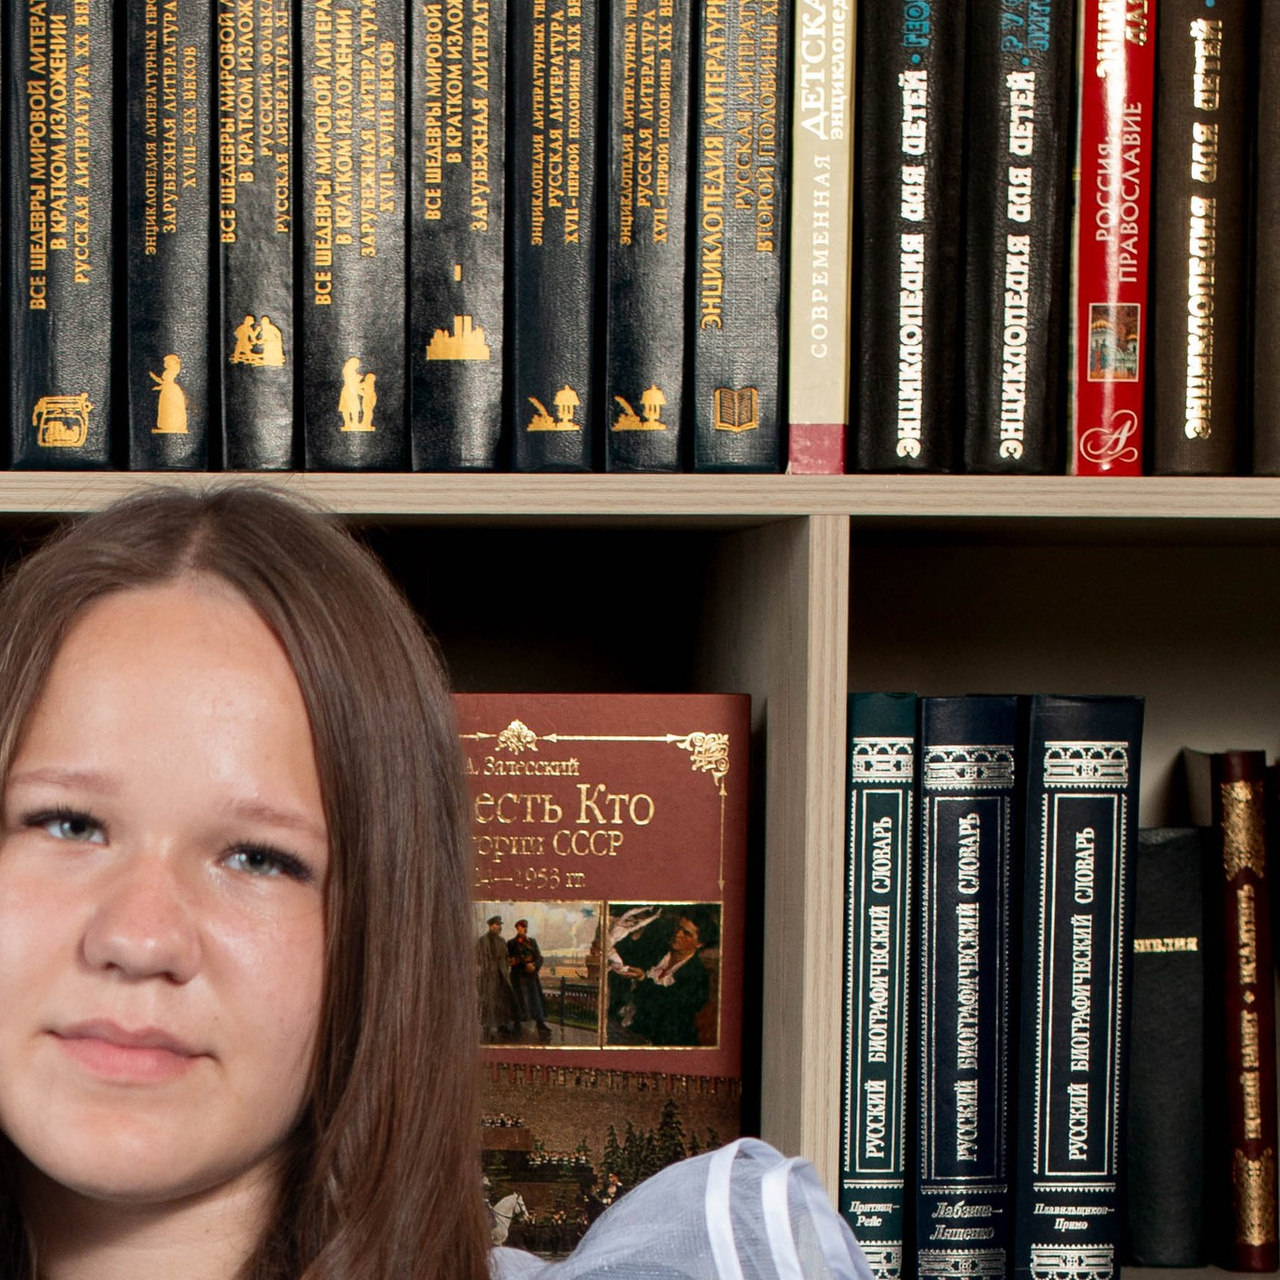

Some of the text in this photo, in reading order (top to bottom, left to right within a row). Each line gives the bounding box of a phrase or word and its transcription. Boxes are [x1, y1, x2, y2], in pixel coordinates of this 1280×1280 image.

[50, 14, 70, 249] В КРАТКОМ ИЗЛОЖЕНИИ
[74, 63, 93, 188] ЛИТЕРАТУРА
[145, 29, 160, 254] ЭНЦИКЛОПЕДИЯ ЛИТЕРАТУРНЫХ
[163, 0, 180, 233] ЗАРУБЕЖНАЯ ЛИТЕРАТУРА
[182, 46, 197, 102] ВЕКОВ
[257, 72, 275, 156] РУССКИЙ
[334, 8, 355, 136] ИЗЛОЖЕНИИ
[548, 9, 567, 207] РУССКАЯ ЛИТЕРАТУРА
[754, 25, 779, 256] ВТОРОЙ ПОЛОВИНЫ
[27, 80, 48, 309] ВСЕ ШЕДЕВРЫ МИРОВОЙ
[74, 194, 92, 283] РУССКАЯ
[701, 136, 728, 336] ЭНЦИКЛОПЕДИЯ
[811, 153, 831, 358] СОВРЕМЕННАЯ
[896, 69, 928, 458] ЭНЦИКЛОПЕДИЯ ДЛЯ ДЕТЕЙ
[1117, 98, 1142, 288] ПРАВОСЛАВИЕ
[474, 783, 655, 826] есть Кто
[552, 829, 624, 856] СССР
[865, 816, 893, 1158] РУССКИЙ БИОГРАФИЧЕСКИЙ СЛОВАРЬ
[955, 812, 981, 1161] РУССКИЙ БИОГРАФИЧЕСКИЙ СЛОВАРЬ
[1067, 827, 1095, 1160] РУССКИЙ БИОГРАФИЧЕСКИЙ СЛОВАРЬ
